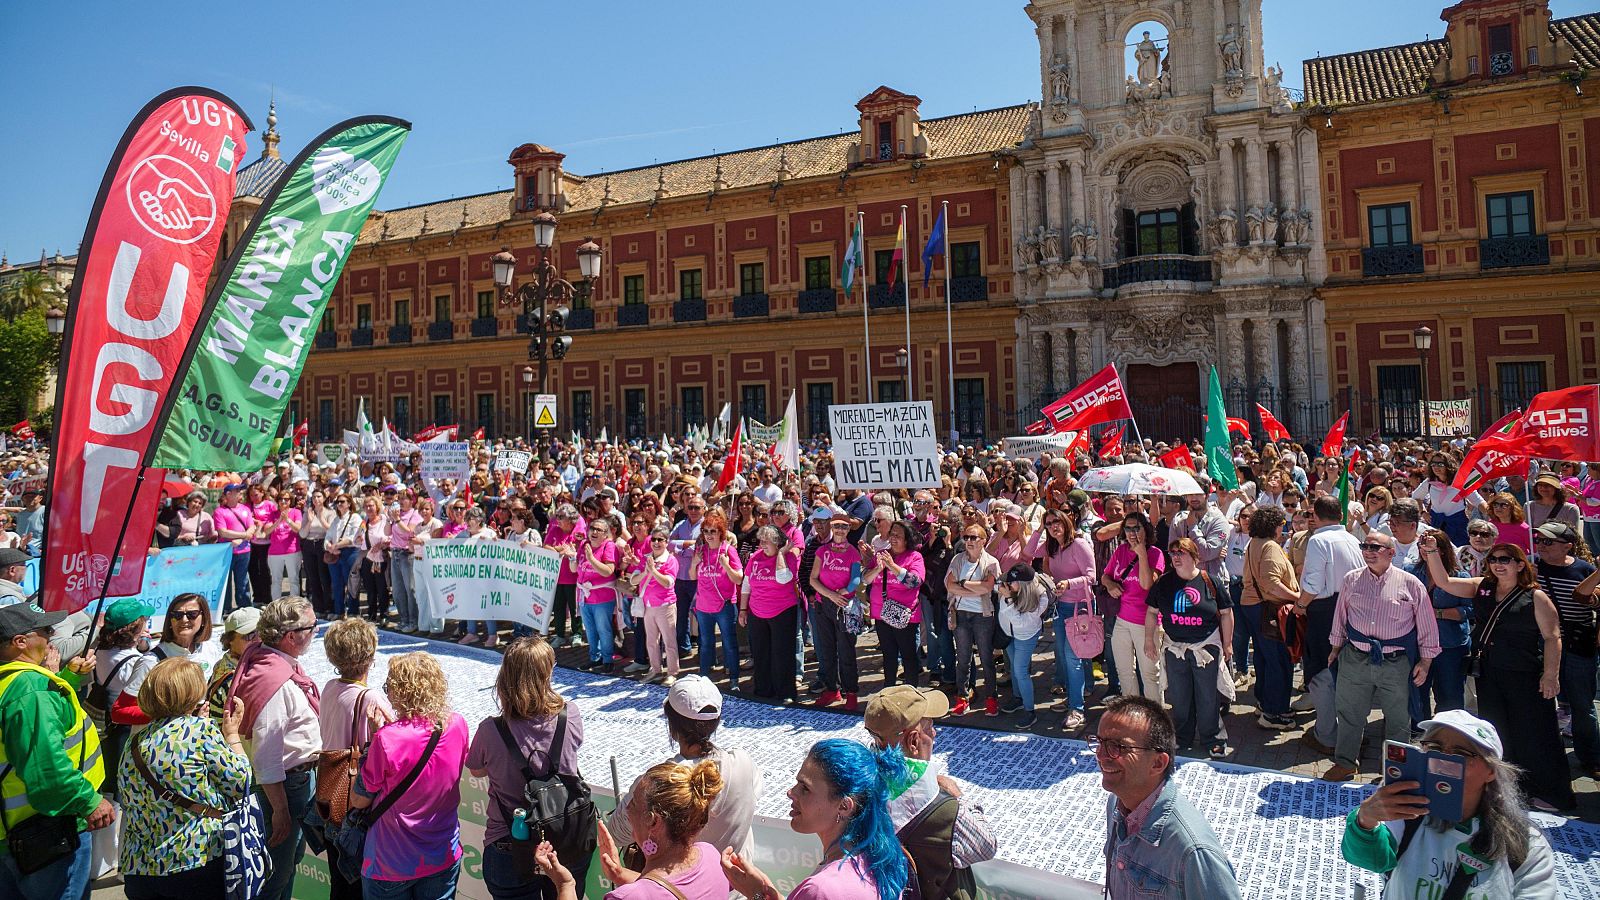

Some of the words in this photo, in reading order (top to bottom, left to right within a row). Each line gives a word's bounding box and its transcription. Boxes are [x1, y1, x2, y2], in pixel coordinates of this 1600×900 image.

[181, 99, 235, 130] UGT
[160, 120, 210, 163] Sevilla
[207, 216, 303, 365] MAREA
[250, 231, 354, 399] BLANCA
[80, 240, 190, 535] UGT
[184, 384, 243, 420] A.G.S.
[249, 407, 271, 433] DE
[1420, 400, 1469, 410] BLLAVISTA
[188, 418, 253, 461] OSUNA
[834, 424, 885, 440] VUESTRA
[892, 422, 932, 439] MALA
[508, 451, 530, 461] VENDE
[854, 437, 914, 456] GESTIÓN
[497, 459, 505, 467] TU
[506, 459, 527, 470] SALUD
[842, 460, 883, 484] NOS
[887, 458, 937, 482] MATA
[425, 544, 477, 559] PLATAFORMA
[480, 544, 527, 566] CIUDADANA
[528, 552, 536, 567] 24
[537, 555, 560, 574] HORAS
[432, 565, 443, 578] DE
[443, 565, 476, 578] SANIDAD
[478, 565, 491, 579] EN
[494, 565, 528, 585] ALCOLEA
[529, 572, 543, 590] DEL
[490, 592, 502, 606] YA
[1170, 613, 1203, 626] Peace
